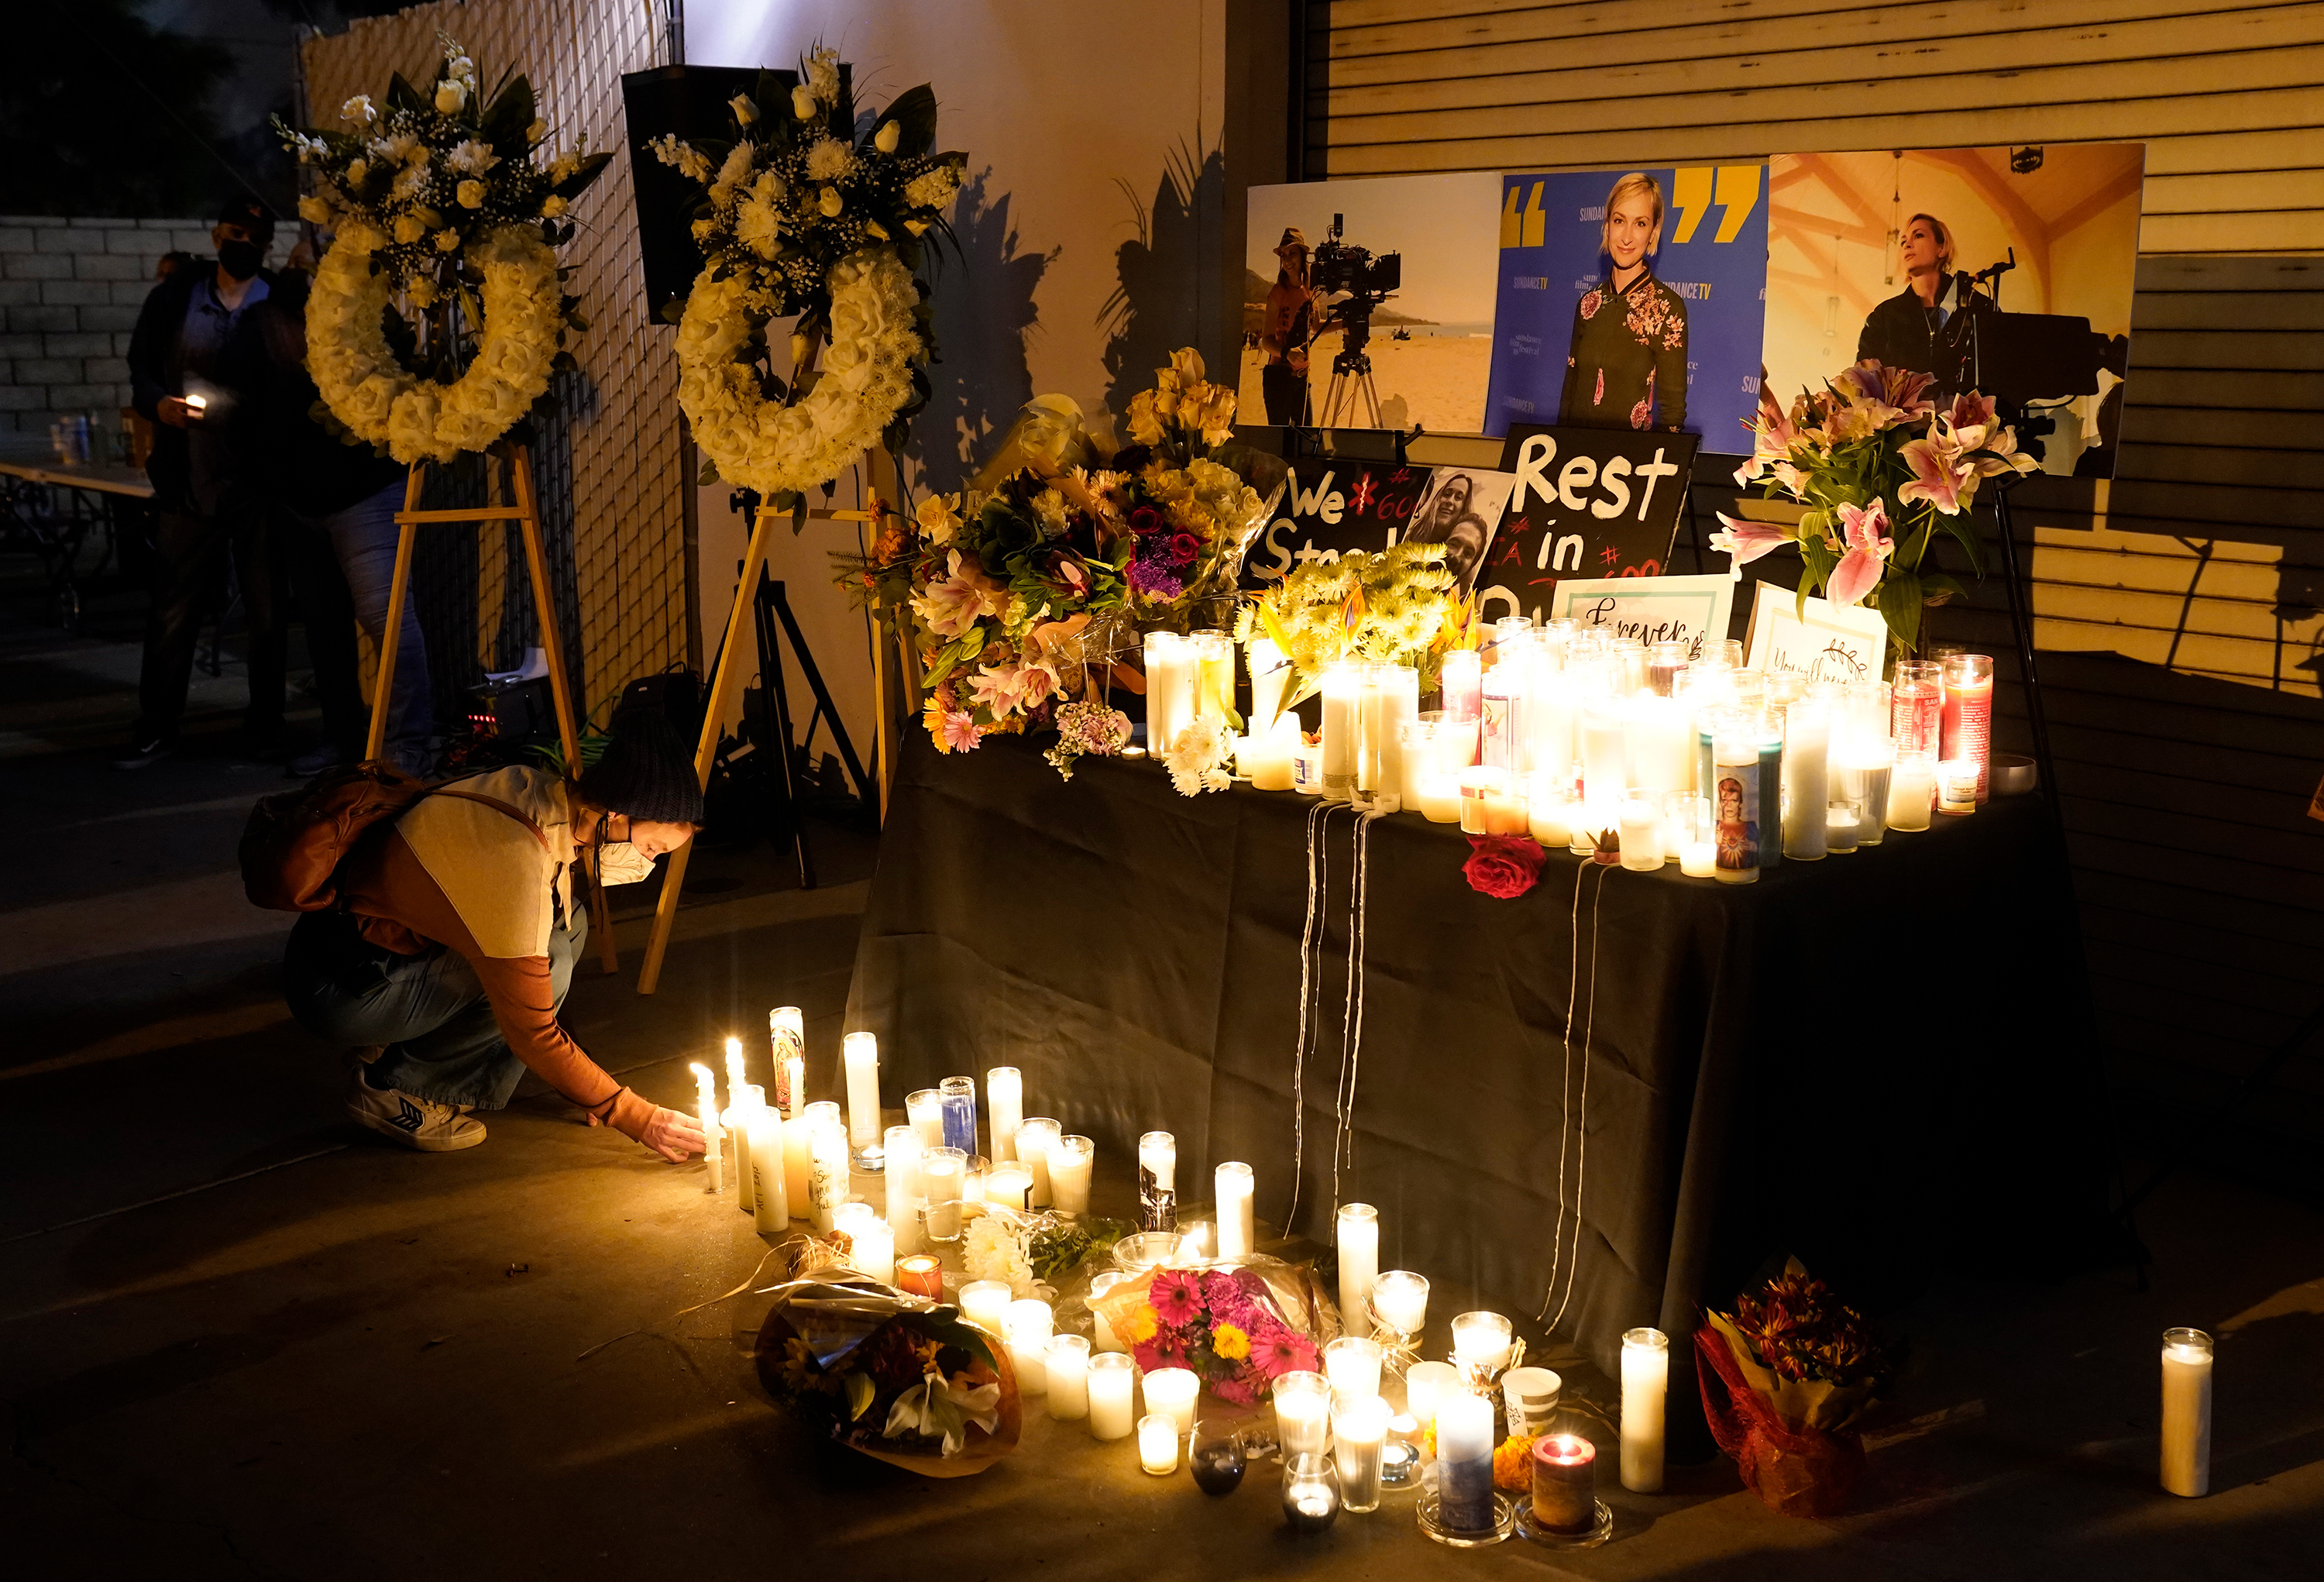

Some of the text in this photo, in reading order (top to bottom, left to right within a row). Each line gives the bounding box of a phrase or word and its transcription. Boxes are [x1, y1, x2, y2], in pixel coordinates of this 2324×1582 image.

[1286, 466, 1345, 524] We
[1511, 434, 1679, 522] Rest
[1536, 519, 1584, 571] in
